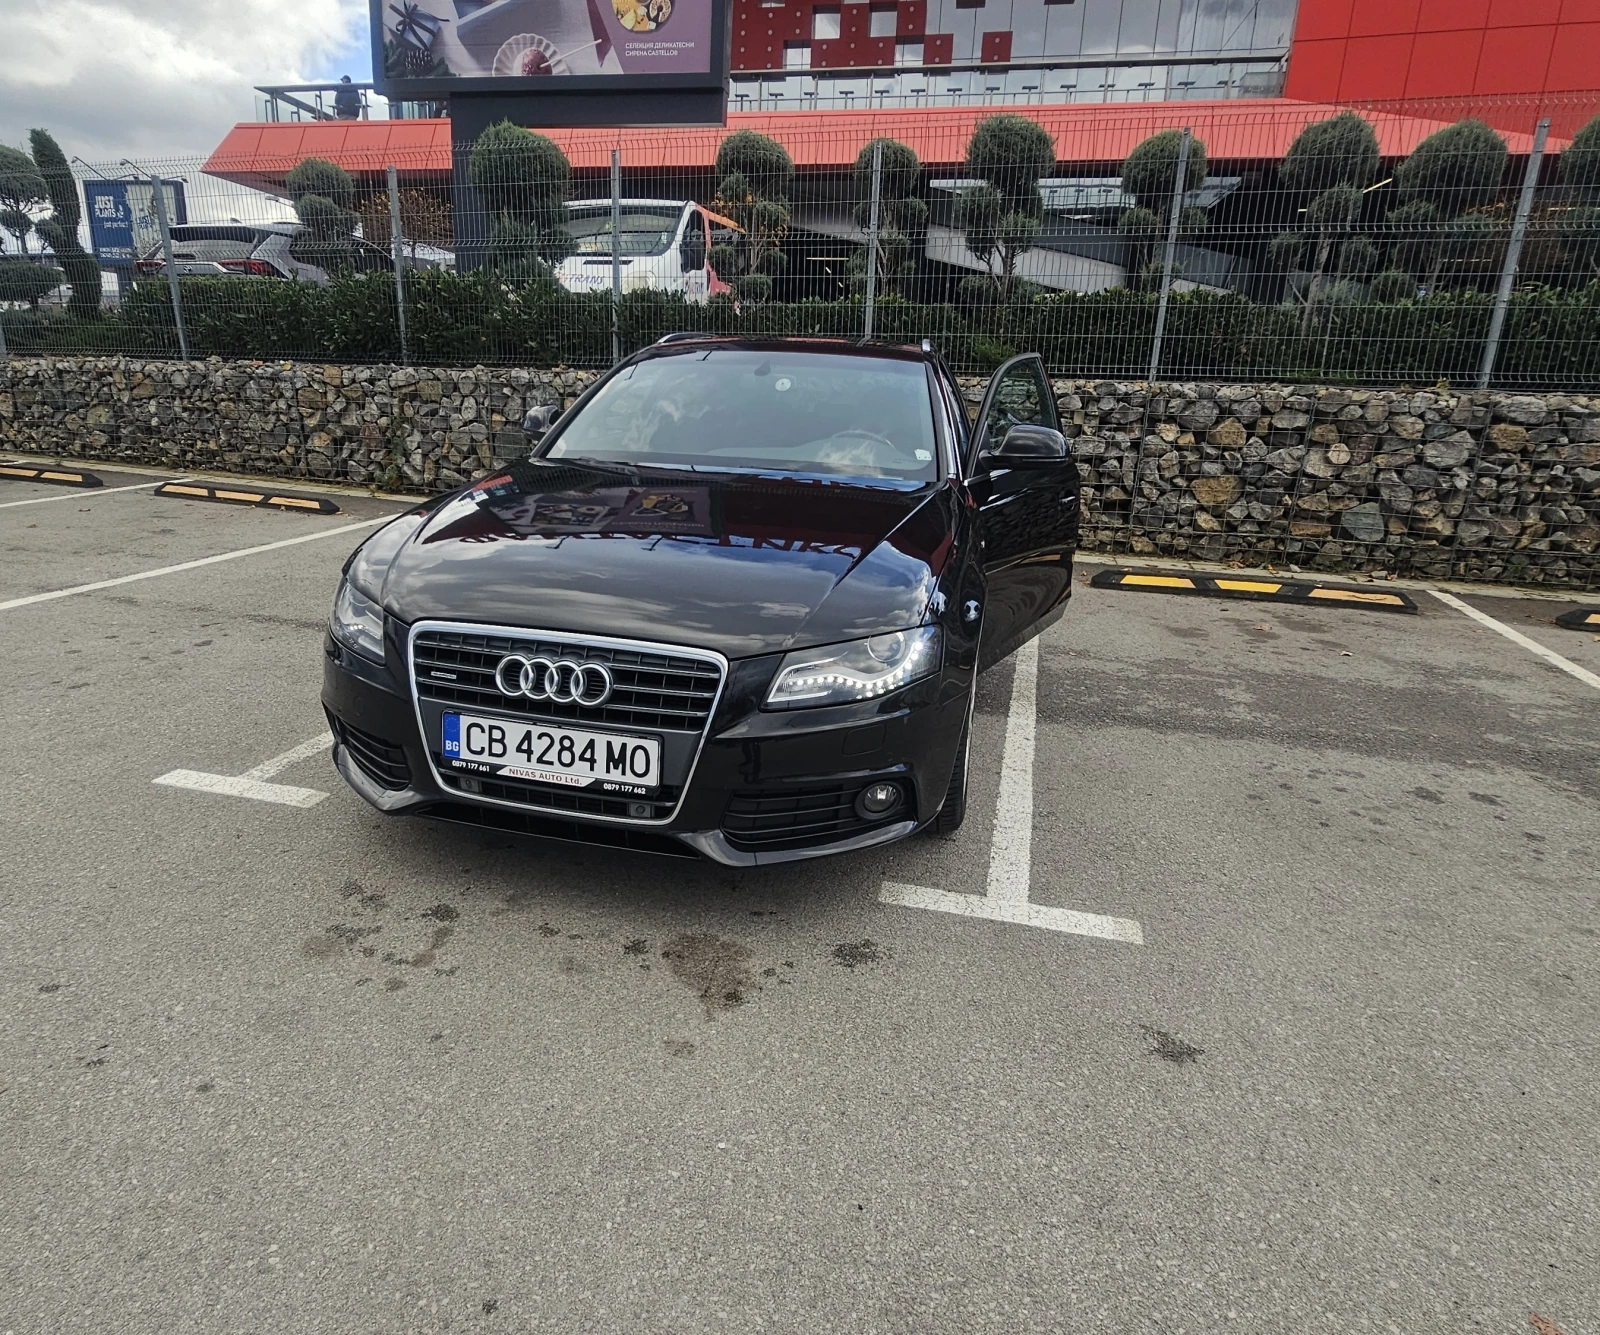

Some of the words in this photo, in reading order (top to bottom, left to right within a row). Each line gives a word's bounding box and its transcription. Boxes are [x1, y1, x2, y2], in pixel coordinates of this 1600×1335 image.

[94, 196, 114, 209] JUST
[94, 208, 116, 218] PLANTS
[445, 740, 459, 751] BG
[466, 722, 508, 758] CB
[516, 730, 597, 772] 4284
[606, 740, 650, 778] MO
[452, 760, 466, 768] 0879
[467, 762, 478, 770] 177
[479, 764, 490, 772] 661
[509, 768, 536, 778] NIVAS
[538, 772, 562, 782] AUTO
[565, 776, 582, 785] Ltd.
[603, 782, 619, 790] 0879
[634, 786, 646, 794] 662
